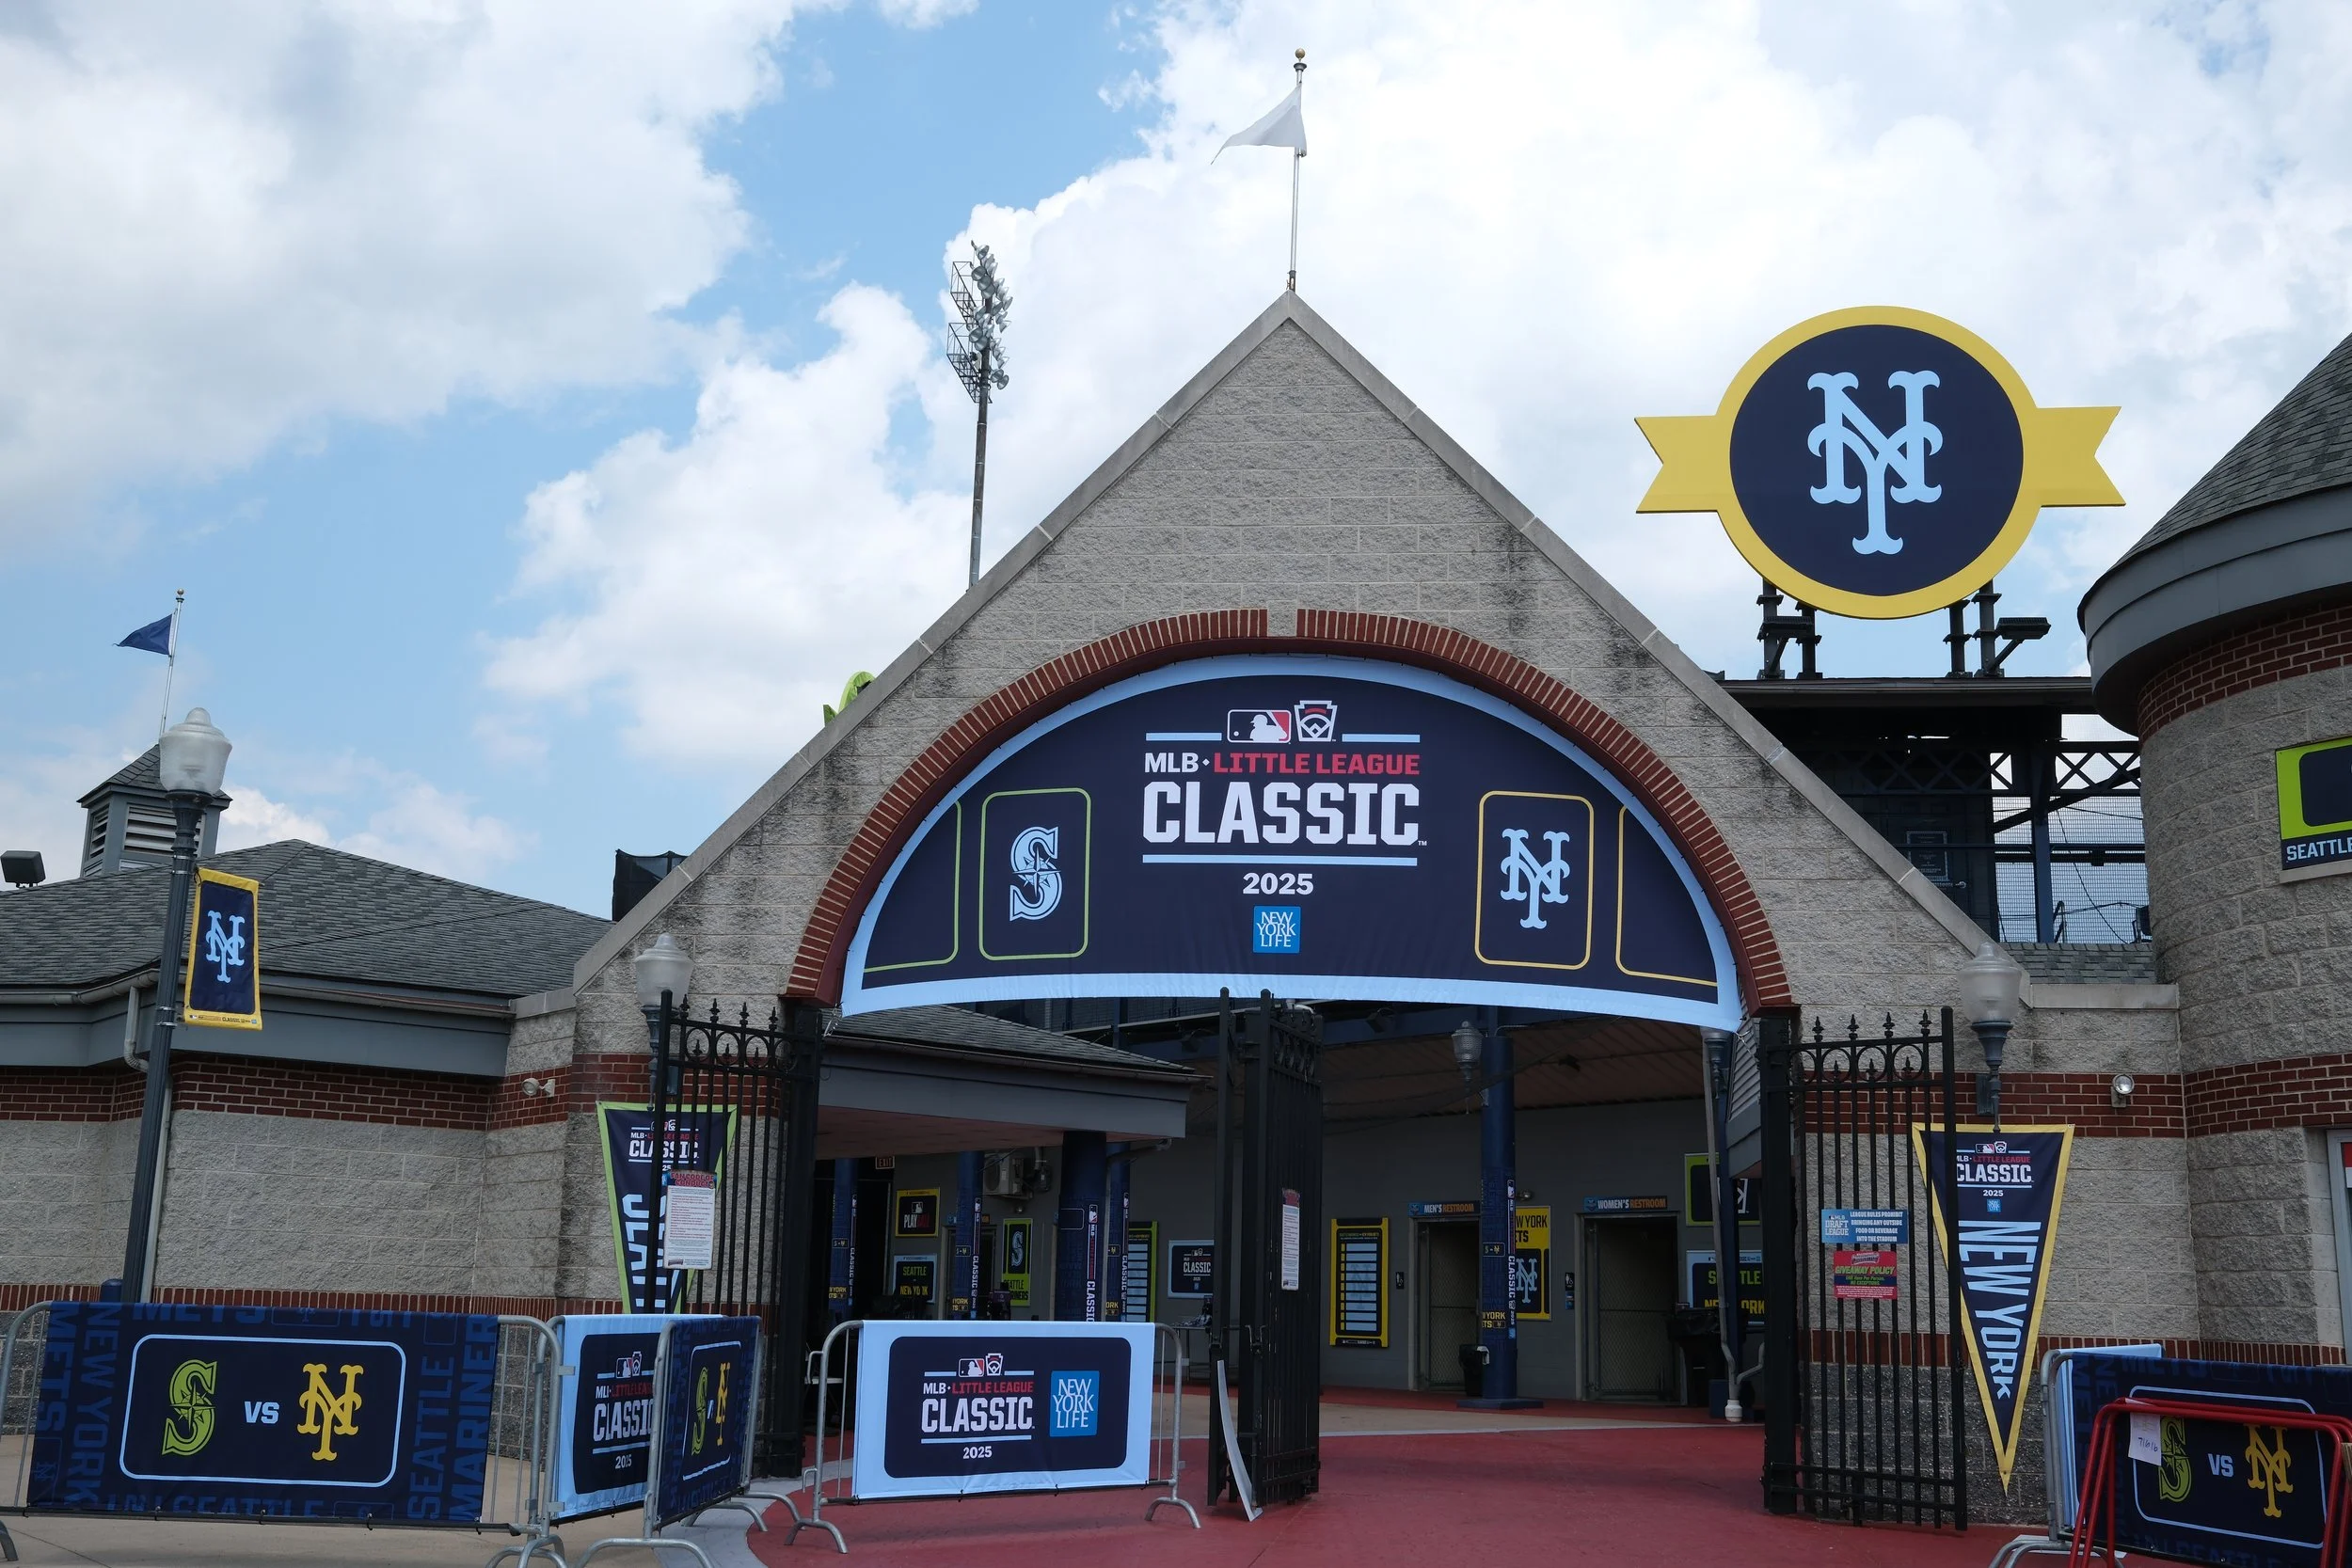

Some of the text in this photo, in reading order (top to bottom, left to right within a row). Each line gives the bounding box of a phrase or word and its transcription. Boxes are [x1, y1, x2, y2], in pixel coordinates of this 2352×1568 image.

[1145, 752, 1421, 775] MLB LITTLE LEAGUE
[1143, 781, 1420, 846] CLASSIC
[1243, 872, 1314, 895] 2025
[1261, 911, 1294, 925] NEW
[1257, 923, 1296, 936] YORK
[1261, 935, 1292, 947] LIFE
[879, 1157, 893, 1167] EXIT
[1957, 1164, 2032, 1183] CLASSIC
[1423, 1203, 1474, 1213] MEN'S RESTROOM
[1597, 1198, 1667, 1210] WOMEN'S RESTROOM
[903, 1214, 917, 1228] PLAY
[1525, 1215, 1548, 1228] YORK
[1825, 1220, 1849, 1228] DRAFT
[903, 1265, 927, 1276] SEATTLE
[1183, 1262, 1212, 1273] CLASSIC
[1004, 1280, 1024, 1290] ATTLE
[1958, 1220, 2042, 1400] NEW YORK
[923, 1381, 1035, 1394] MLB LITTLE LEAGUE
[1058, 1379, 1092, 1395] NEW
[1053, 1394, 1094, 1412] YORK
[921, 1397, 1033, 1433] CLASSIC
[1057, 1411, 1089, 1428] LIFE
[407, 1355, 455, 1519] SEATTLE
[962, 1446, 993, 1459] 2025
